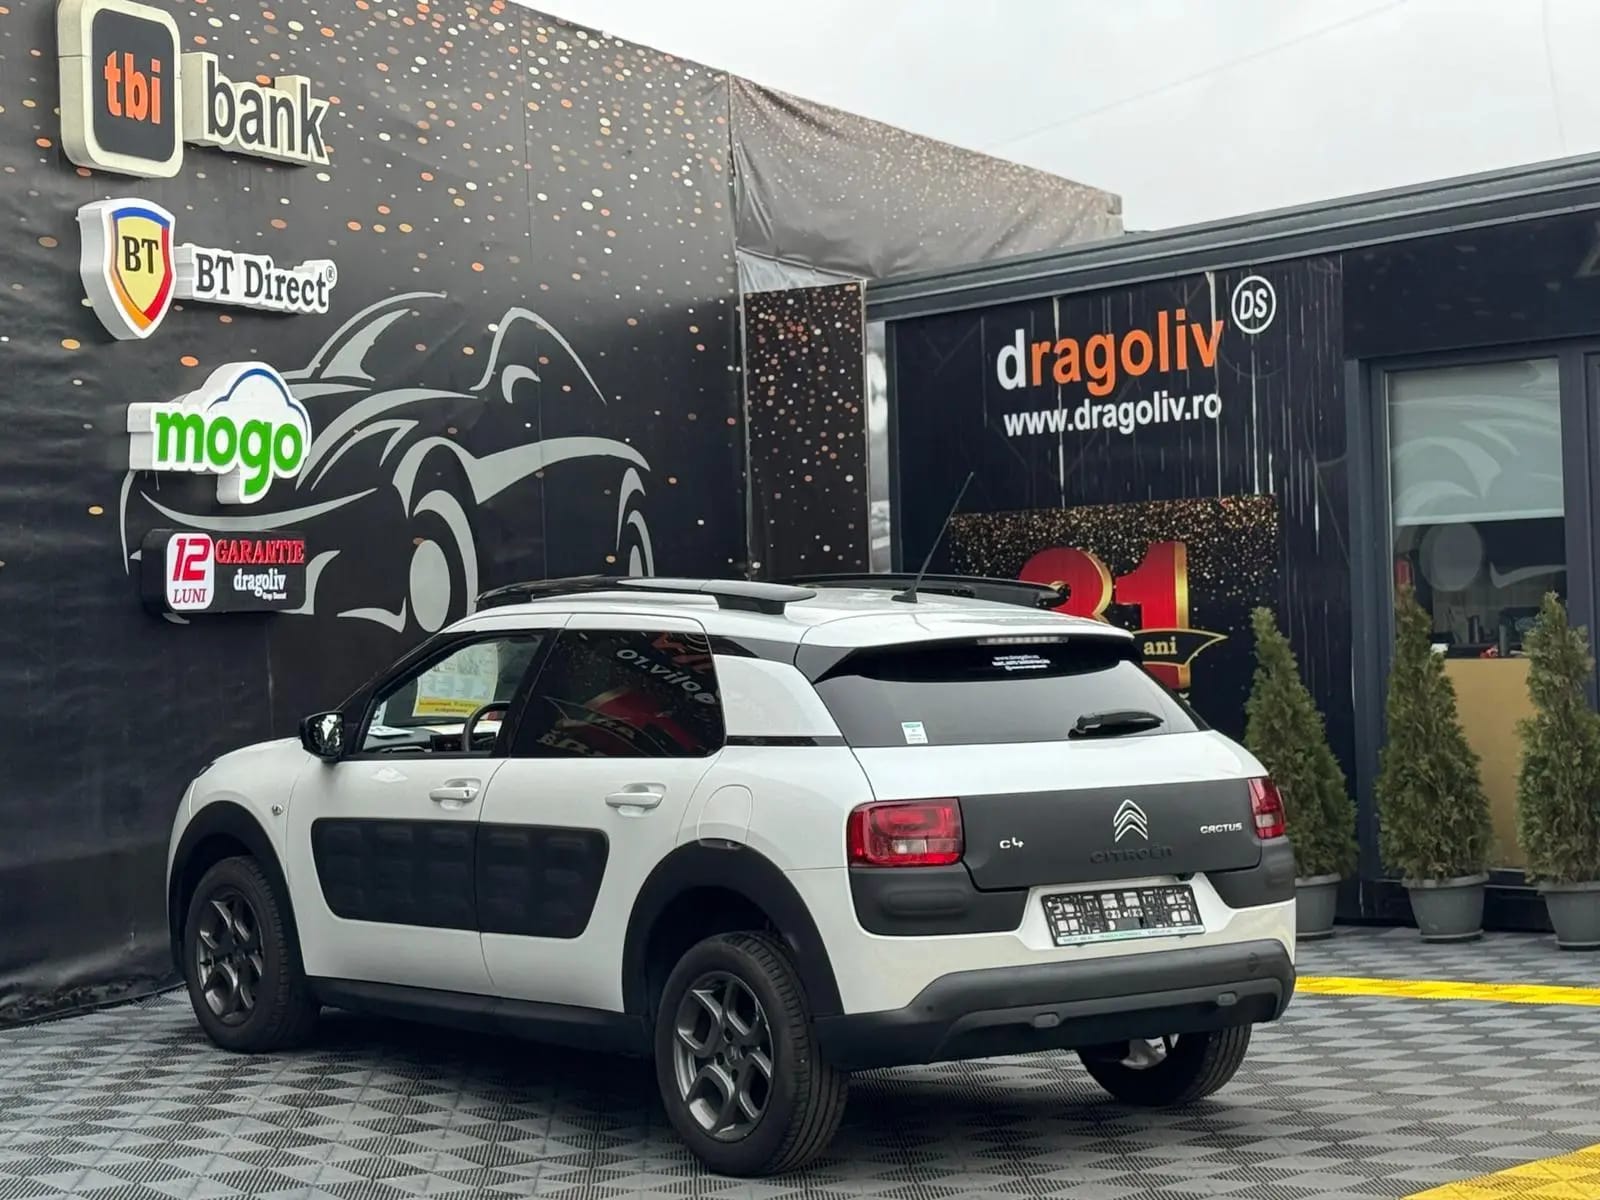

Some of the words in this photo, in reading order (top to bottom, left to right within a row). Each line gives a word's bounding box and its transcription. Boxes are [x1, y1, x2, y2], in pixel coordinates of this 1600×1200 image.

[104, 51, 160, 124] tbi
[207, 60, 325, 158] bank
[122, 236, 158, 274] BT
[196, 253, 235, 295] BT
[1239, 287, 1268, 320] DS
[997, 308, 1224, 396] dragoliv
[1003, 390, 1223, 437] www.dragoliv.ro
[156, 411, 303, 496] mogo
[172, 538, 211, 581] 12
[215, 539, 305, 564] GARANTIE
[173, 588, 207, 604] LUNI
[233, 567, 287, 597] dragoliv
[1143, 635, 1178, 656] ani
[1000, 836, 1024, 849] C4
[1200, 822, 1242, 834] CACTUS
